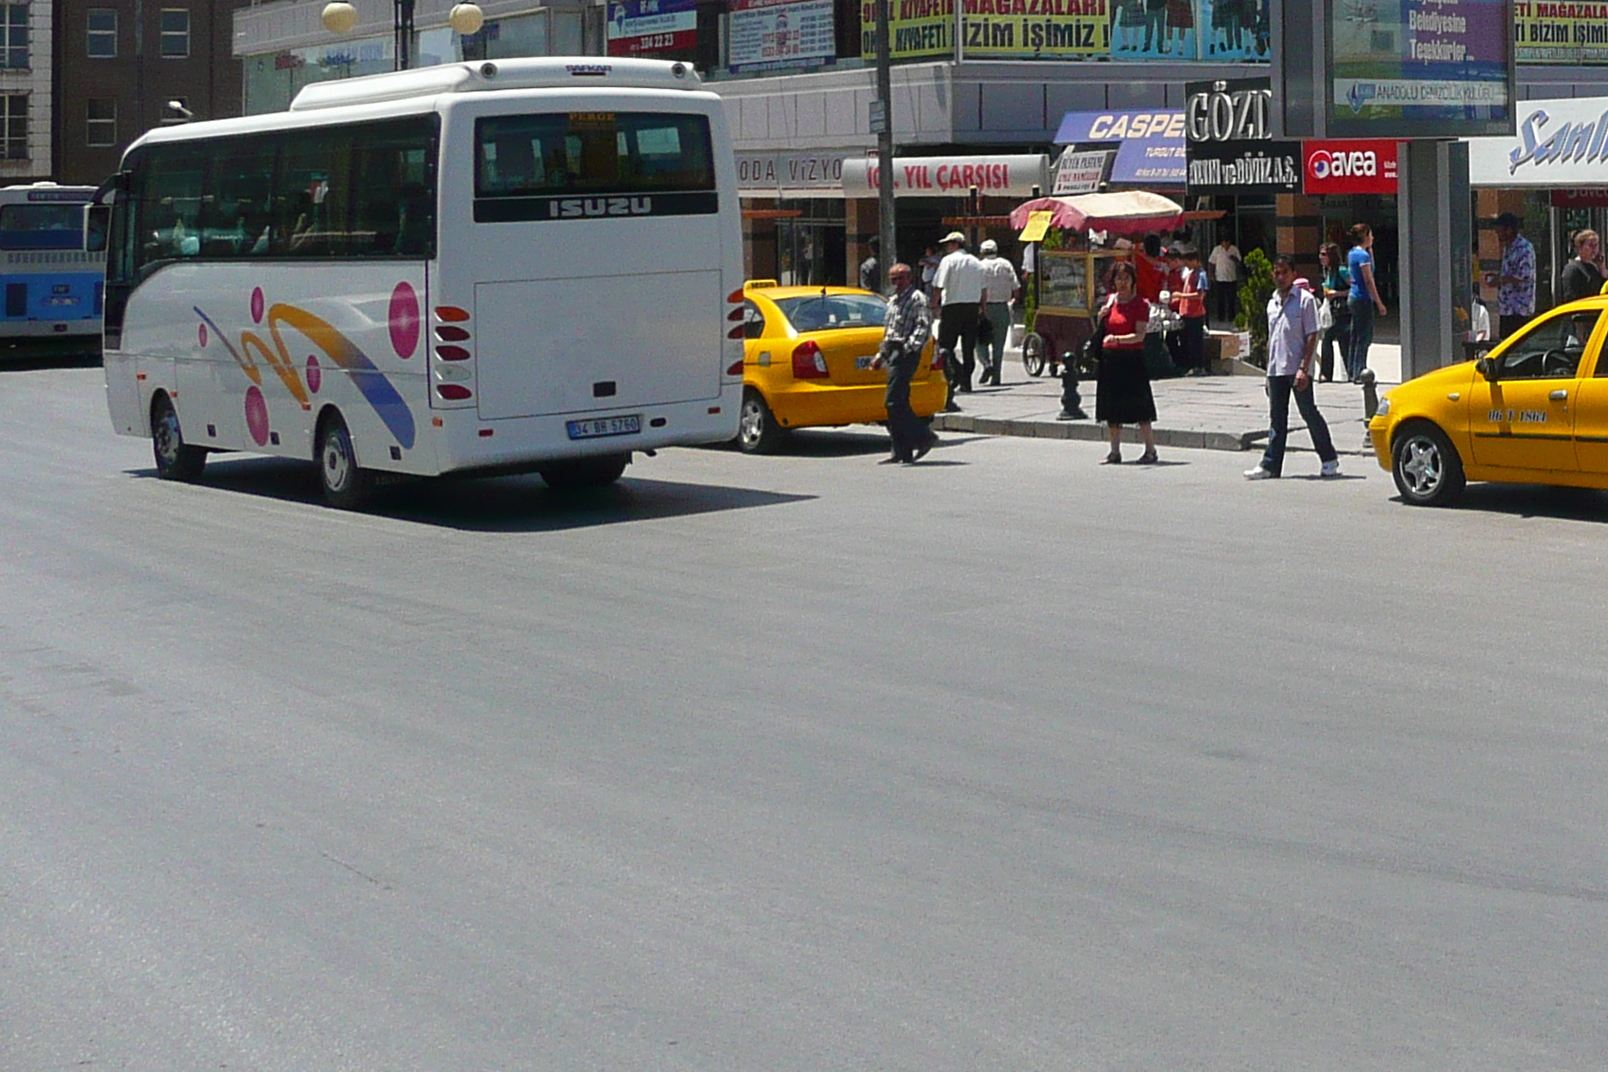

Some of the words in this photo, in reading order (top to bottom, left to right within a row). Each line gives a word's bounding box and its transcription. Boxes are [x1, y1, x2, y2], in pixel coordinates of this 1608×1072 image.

[1409, 10, 1467, 35] Belediyesine
[1529, 20, 1569, 43] BİZİM
[1022, 18, 1095, 52] İŞİMİZ
[1377, 85, 1418, 100] ANADOLU
[1145, 147, 1175, 158] TURGUT
[1331, 150, 1377, 177] avea
[904, 166, 932, 189] YIL
[936, 163, 1009, 193] ÇARŞISI
[1236, 151, 1272, 185] DÖVİZ
[550, 197, 652, 217] ISUZU
[1488, 409, 1503, 422] 06
[1507, 409, 1516, 422] T
